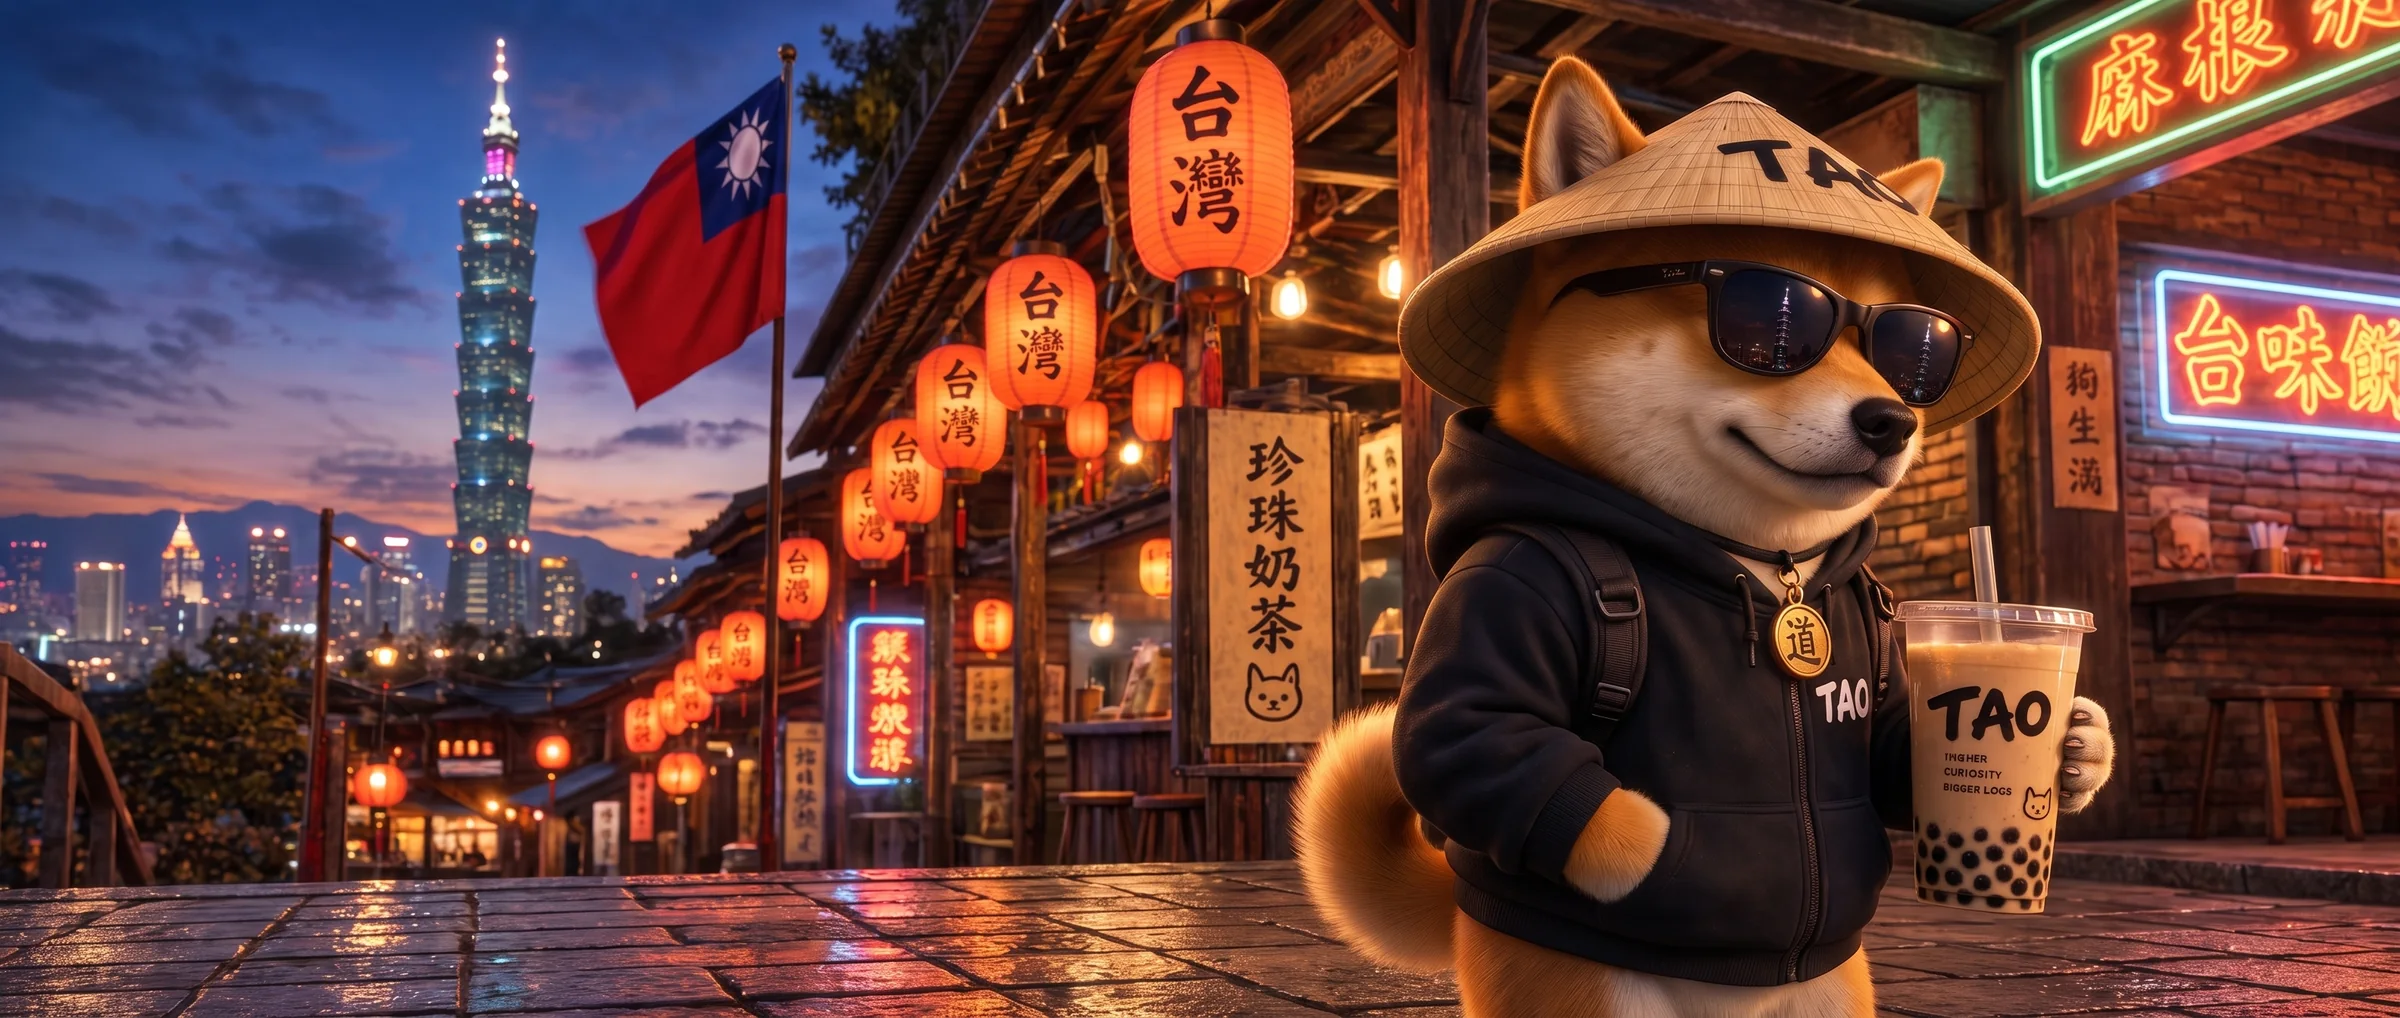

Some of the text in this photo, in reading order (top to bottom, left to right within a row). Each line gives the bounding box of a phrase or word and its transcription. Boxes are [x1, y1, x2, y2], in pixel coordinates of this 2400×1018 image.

[1169, 65, 1244, 234] 台灣
[1717, 139, 1919, 216] TAO
[1017, 270, 1064, 380] 台灣
[941, 359, 980, 447] 台灣
[889, 431, 920, 503] 台灣
[785, 548, 811, 604] 台灣
[1244, 435, 1305, 654] 珍珠奶茶
[1786, 615, 1821, 666] 道
[1816, 678, 1869, 723] TAO
[1927, 686, 2052, 742] TAO
[1943, 782, 2012, 796] BIGGER LOGS
[1944, 767, 2002, 779] CURIOSITY
